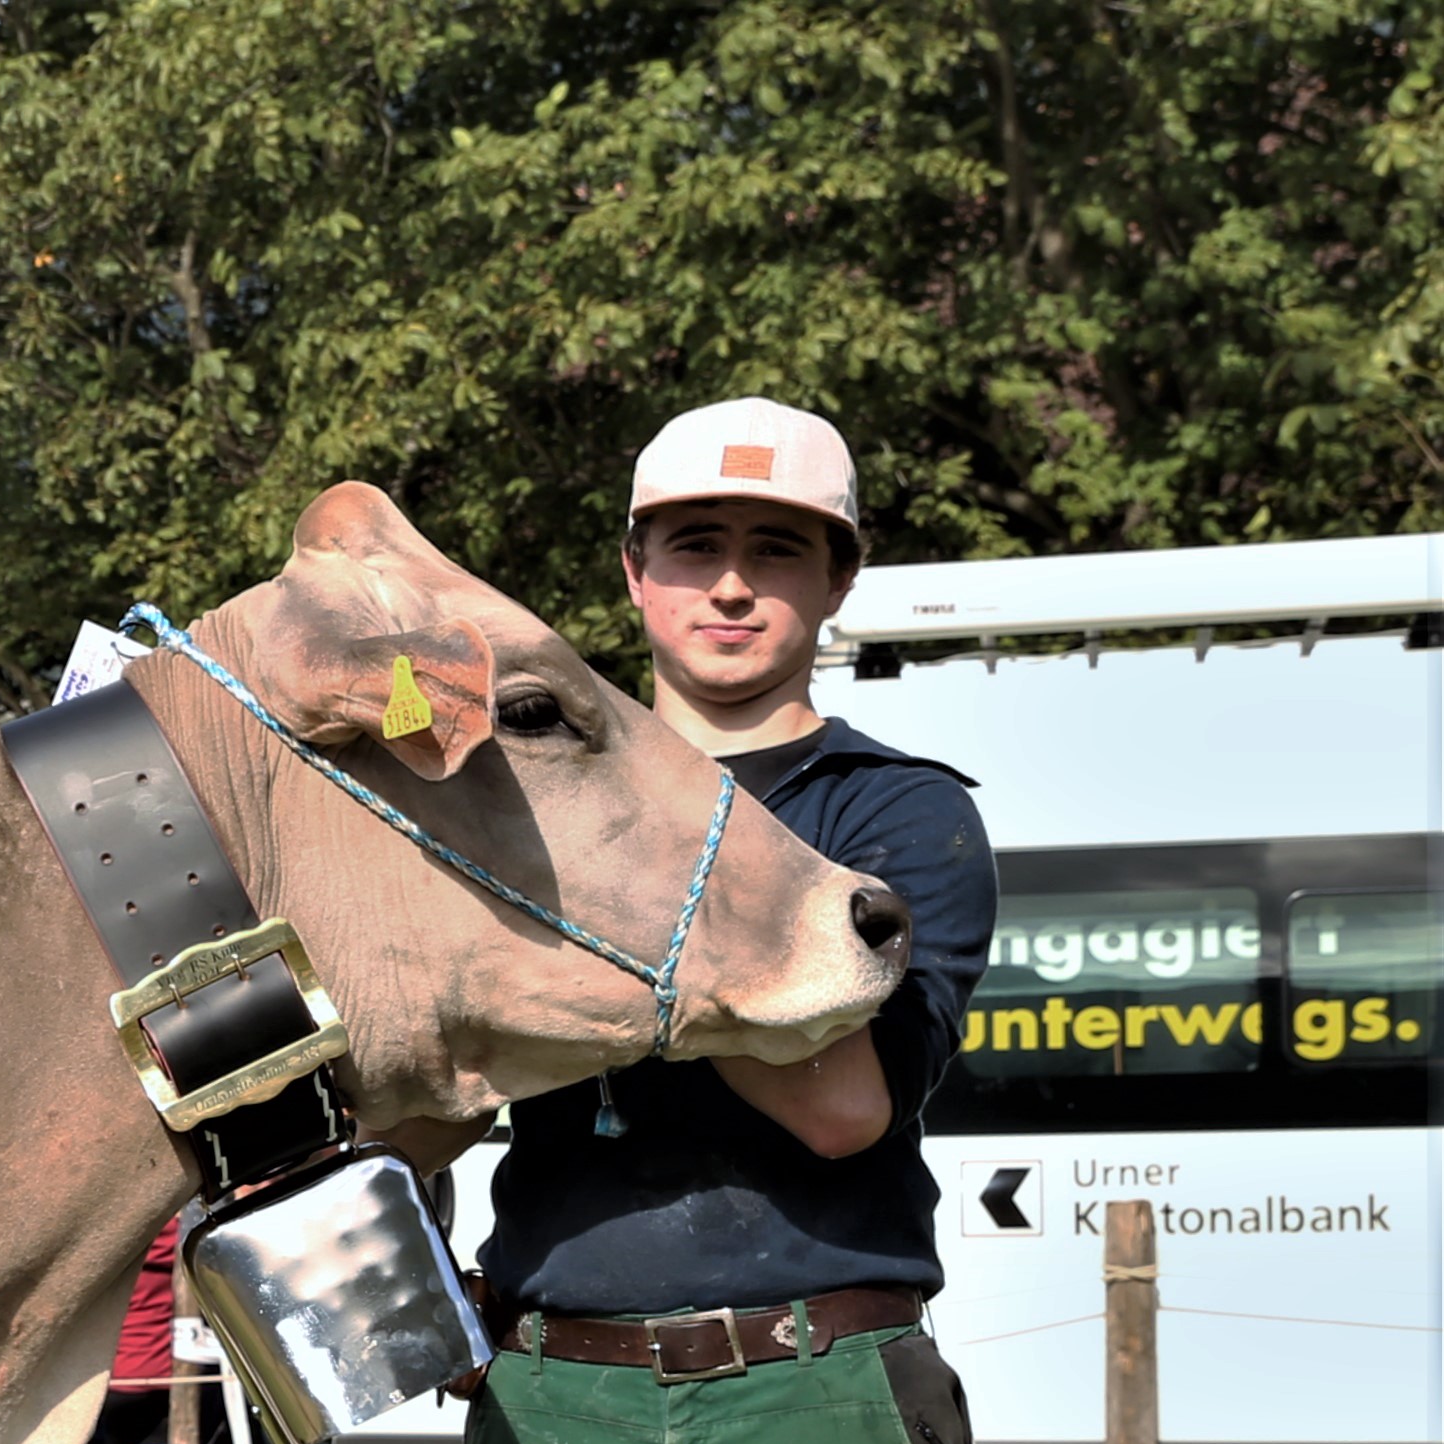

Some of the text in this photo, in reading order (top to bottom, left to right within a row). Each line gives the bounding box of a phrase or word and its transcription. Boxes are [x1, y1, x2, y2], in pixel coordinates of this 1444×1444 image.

[988, 908, 1344, 982] ngagiet
[1073, 1159, 1180, 1188] Urner
[1073, 1194, 1390, 1237] Ktonalbank
